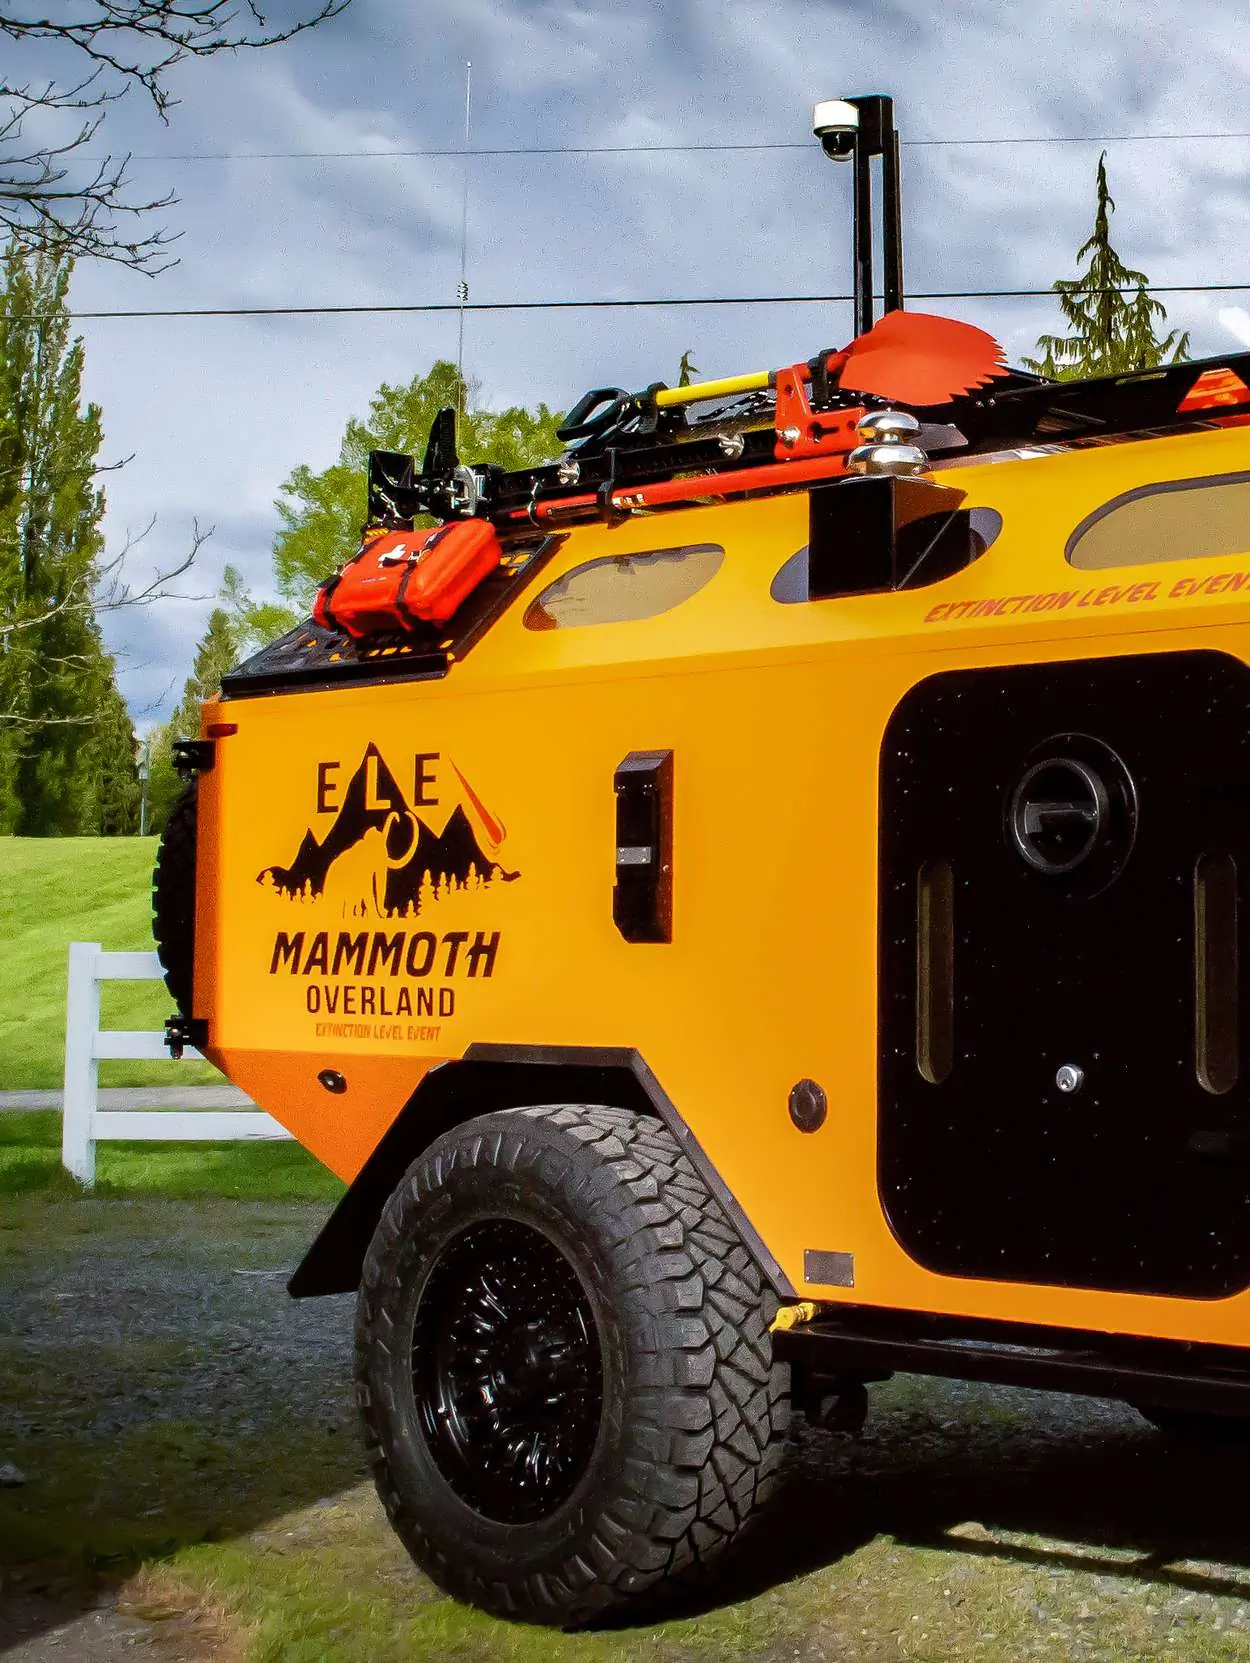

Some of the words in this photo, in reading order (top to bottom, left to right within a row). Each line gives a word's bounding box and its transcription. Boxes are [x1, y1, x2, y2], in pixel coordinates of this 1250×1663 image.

[924, 589, 1080, 623] EXTINCTION
[1077, 581, 1162, 608] LEVEL
[269, 931, 501, 978] MAMMOTH
[306, 984, 456, 1017] OVERLAND
[315, 1023, 372, 1039] EXTINCTION
[374, 1024, 404, 1041] LEVEL
[407, 1024, 441, 1042] EVENT
